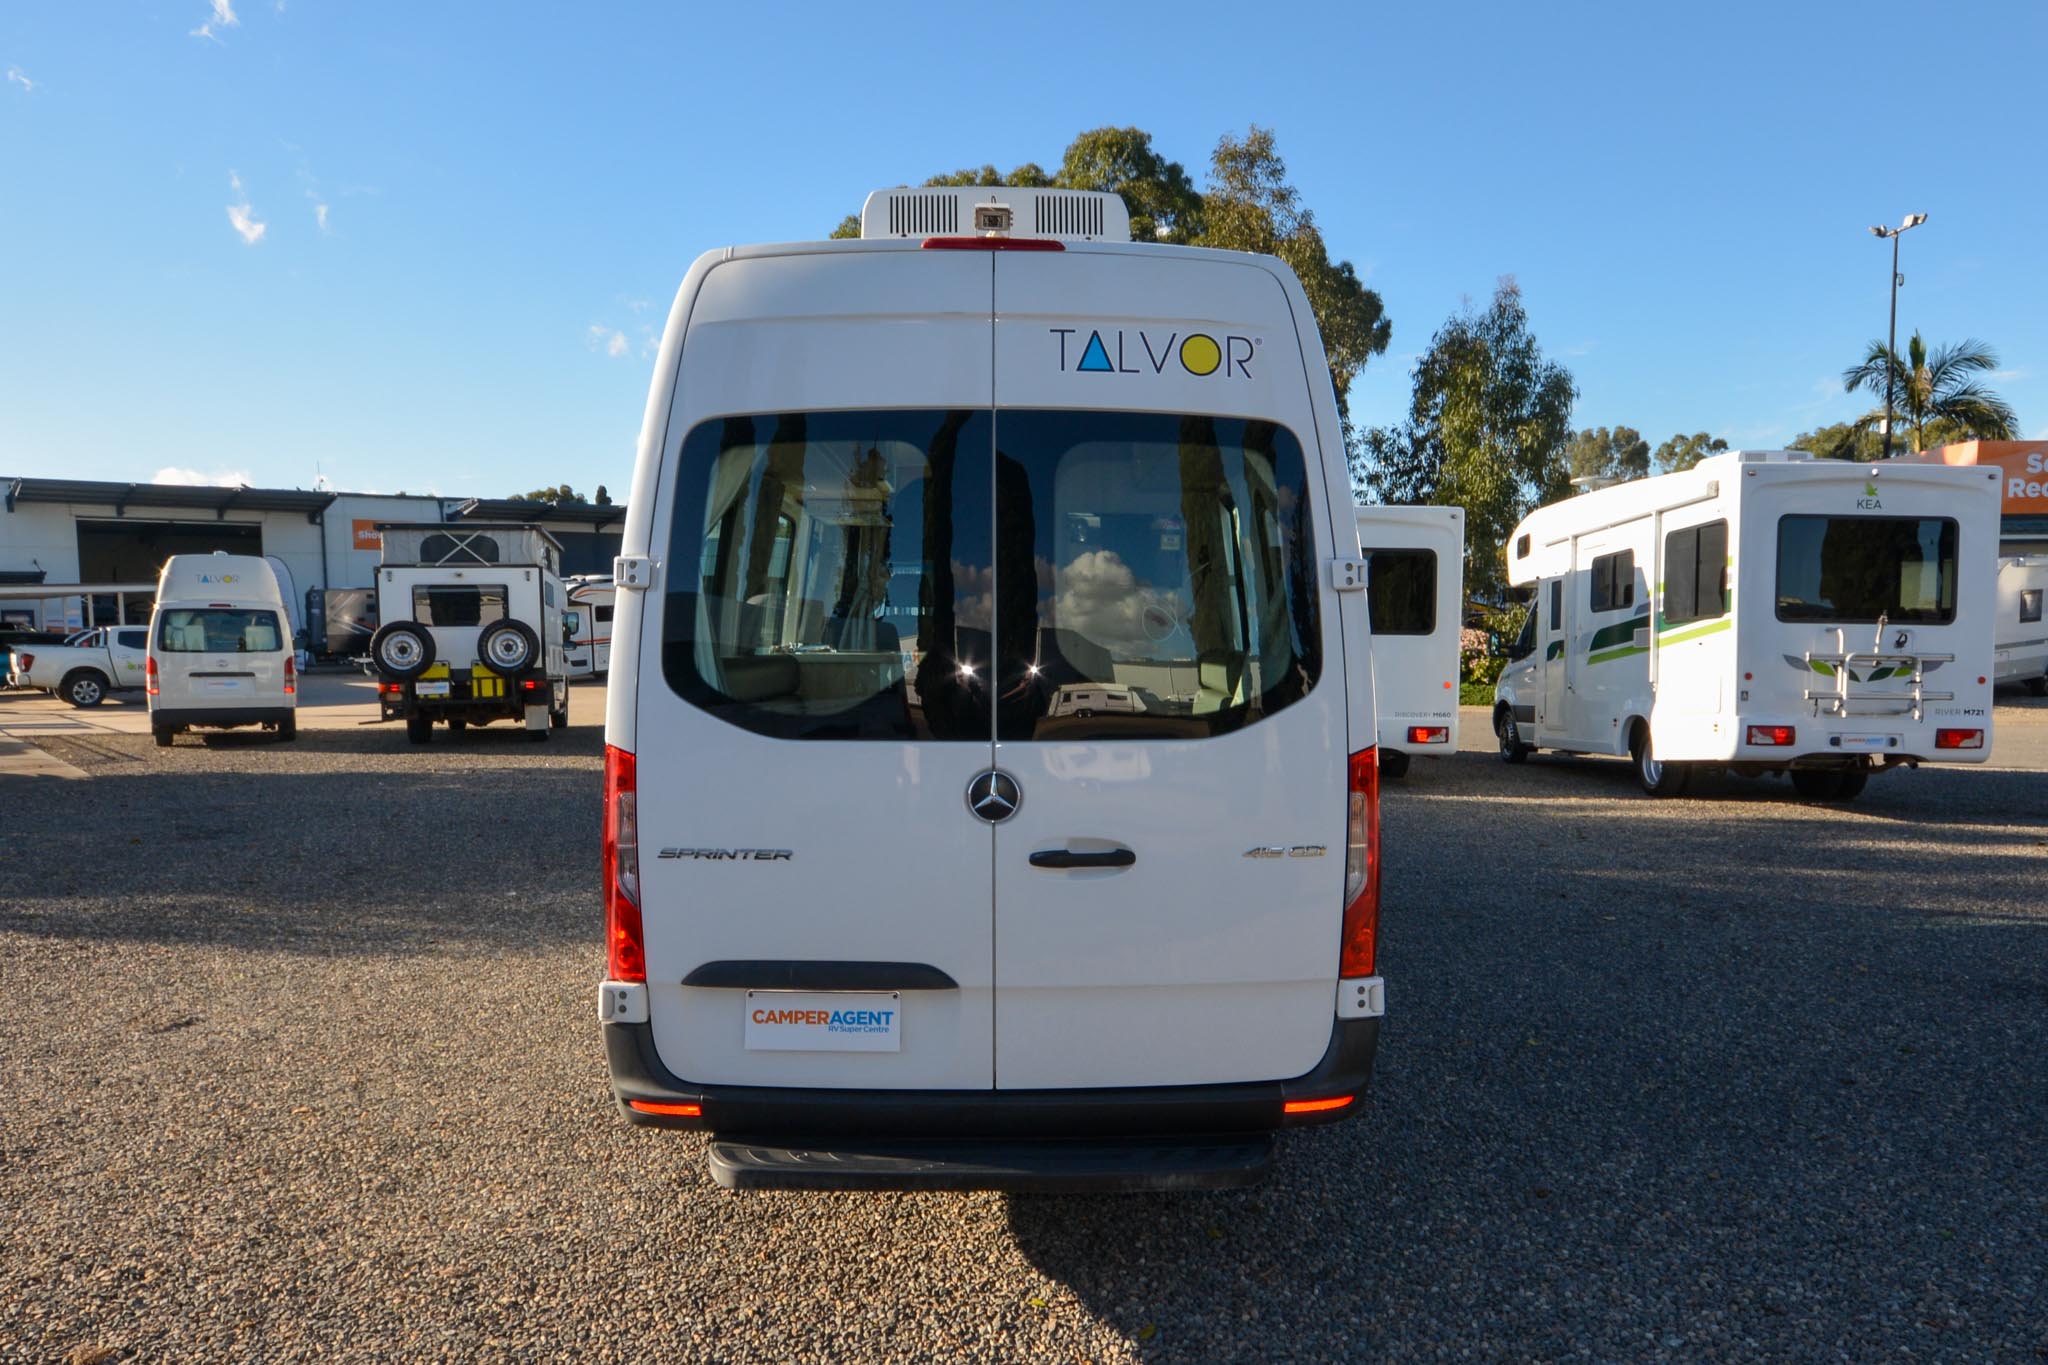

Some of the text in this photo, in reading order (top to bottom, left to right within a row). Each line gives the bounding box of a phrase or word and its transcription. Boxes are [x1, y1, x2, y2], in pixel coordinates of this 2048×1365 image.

[1049, 328, 1253, 379] TALVOR
[1856, 498, 1883, 510] KEA
[194, 574, 241, 585] TALVOR
[1432, 711, 1452, 719] M660
[1935, 707, 1985, 717] RIVER M721
[657, 846, 793, 861] SPRINTER
[751, 1009, 895, 1026] CAMPERAGENT
[863, 1025, 890, 1033] Centre
